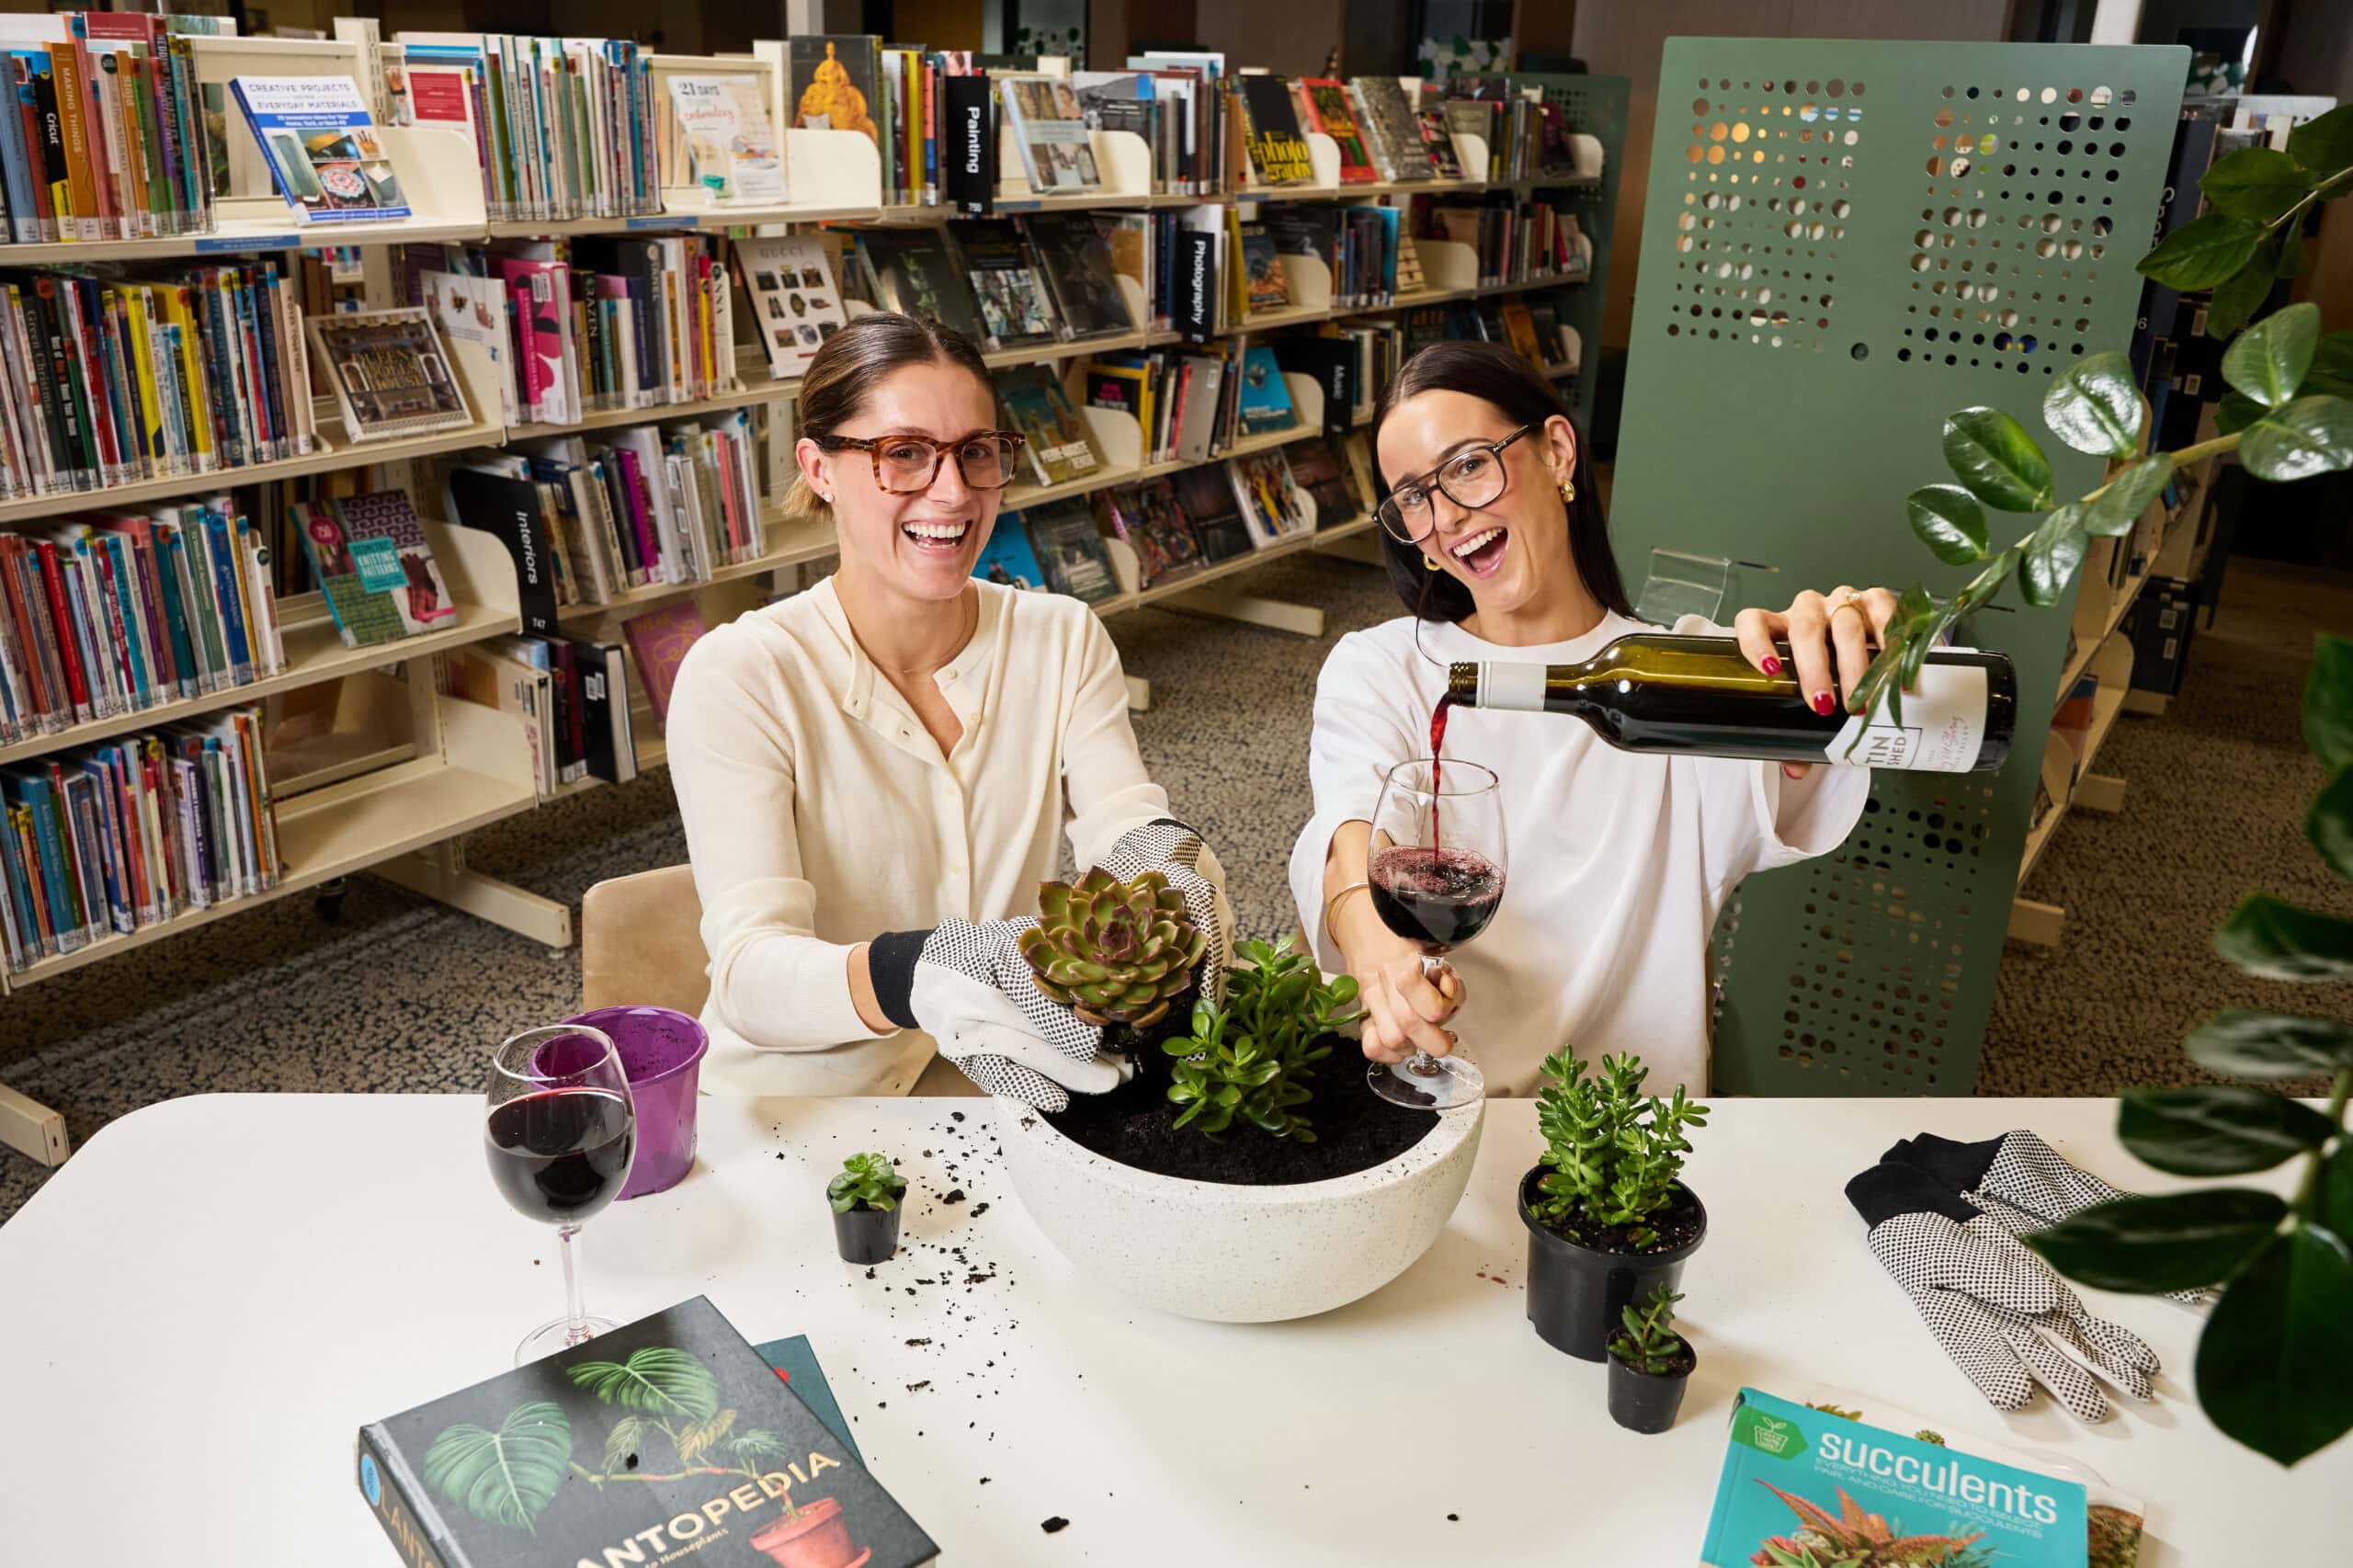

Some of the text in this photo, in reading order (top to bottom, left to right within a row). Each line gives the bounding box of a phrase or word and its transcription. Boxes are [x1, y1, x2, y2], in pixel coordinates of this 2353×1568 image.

[249, 83, 351, 92] CREATIVE PROJECTS
[308, 100, 358, 109] MATERIALS
[62, 66, 83, 153] MAKING THINGS
[45, 112, 61, 145] Cricut
[967, 106, 982, 174] Painting
[759, 245, 804, 258] GUCCI
[1192, 240, 1207, 325] Photography
[27, 310, 55, 415] Green Christmas
[515, 510, 539, 585] Interiors
[1866, 735, 1891, 765] TIN
[1887, 736, 1907, 767] SHED
[1818, 1432, 2058, 1524] succulents
[660, 1528, 729, 1565] Houseplants
